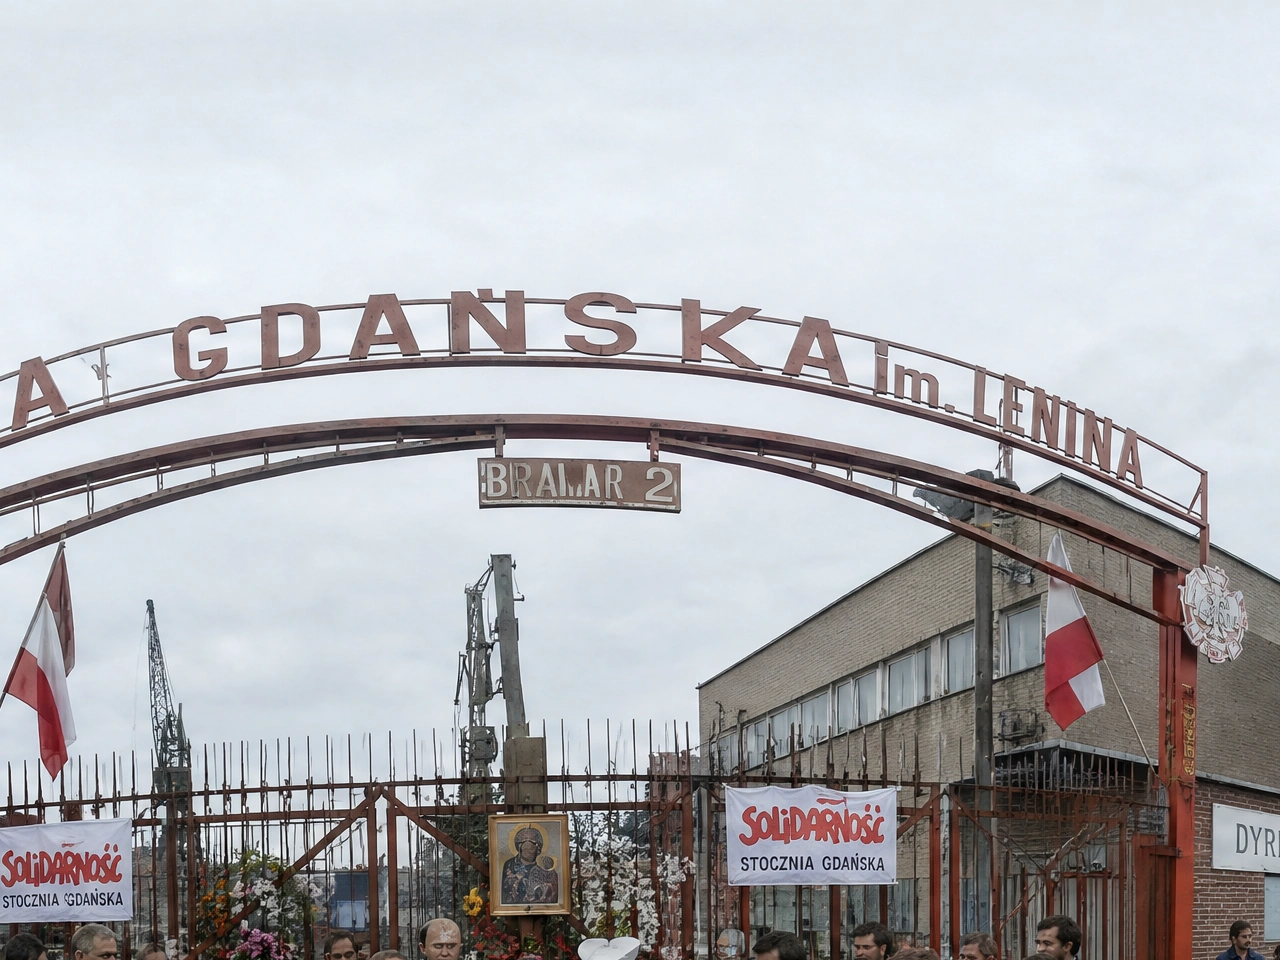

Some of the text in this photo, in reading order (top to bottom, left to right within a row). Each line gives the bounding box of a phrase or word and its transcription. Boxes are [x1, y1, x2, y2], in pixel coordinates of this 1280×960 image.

[172, 288, 850, 387] GDAŃSKA
[972, 364, 1144, 490] LENINA
[645, 466, 674, 502] 2
[740, 853, 885, 872] STOCZNIA GDAŃSKA
[2, 892, 60, 909] STOCZNIA
